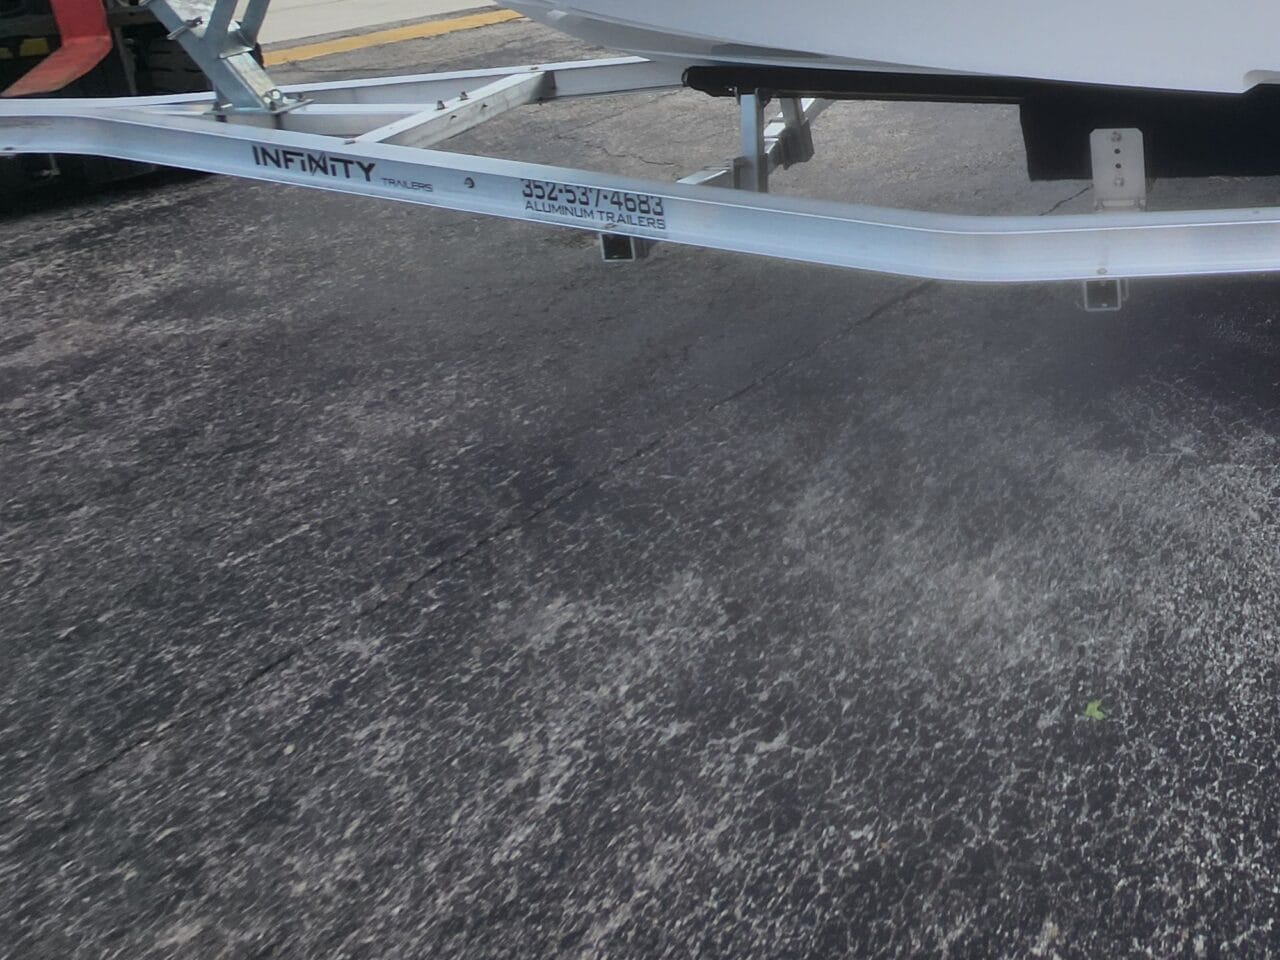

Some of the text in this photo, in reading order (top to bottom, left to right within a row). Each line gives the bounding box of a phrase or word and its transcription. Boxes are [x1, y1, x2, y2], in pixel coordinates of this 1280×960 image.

[381, 176, 434, 193] TRAILERS
[525, 200, 667, 230] ALUMINUM TRAILERS
